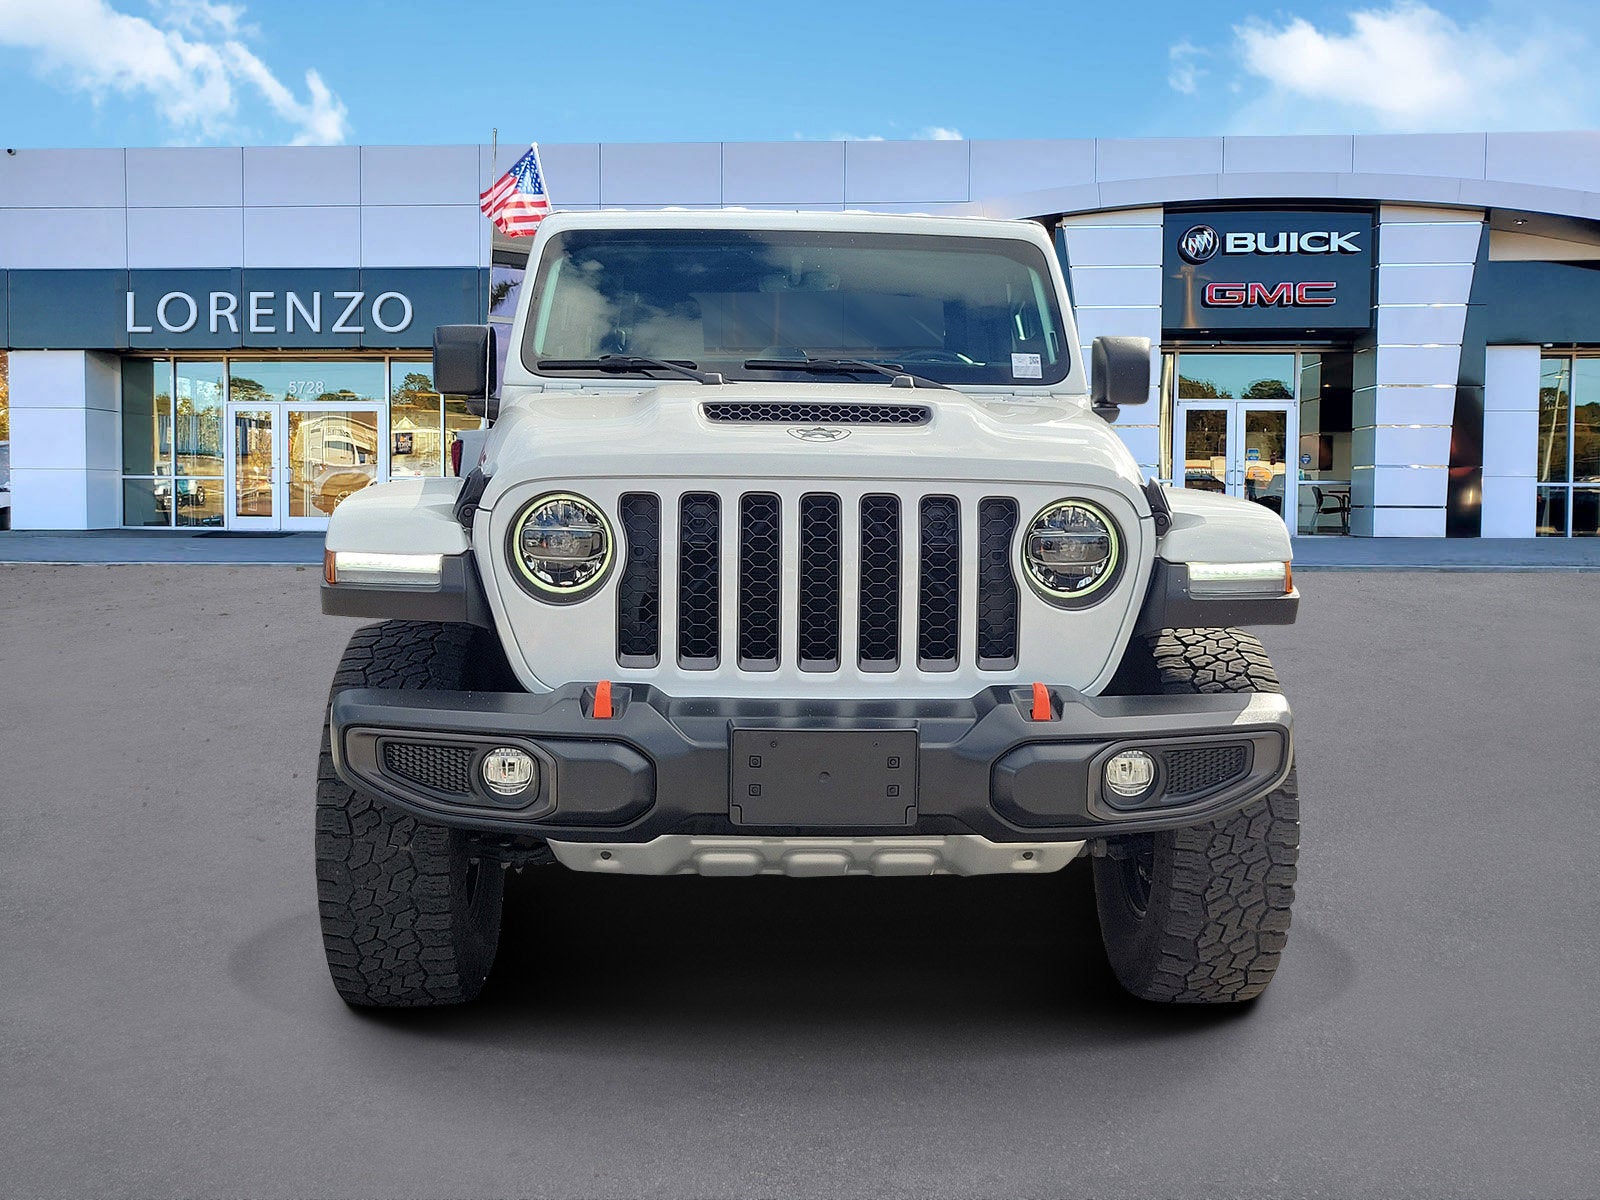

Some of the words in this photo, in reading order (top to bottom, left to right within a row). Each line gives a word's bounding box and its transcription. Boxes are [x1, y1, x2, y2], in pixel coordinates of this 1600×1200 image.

[1224, 231, 1362, 254] BUICK
[1205, 282, 1337, 306] GMC
[126, 291, 415, 334] LORENZO
[288, 380, 325, 394] 5728
